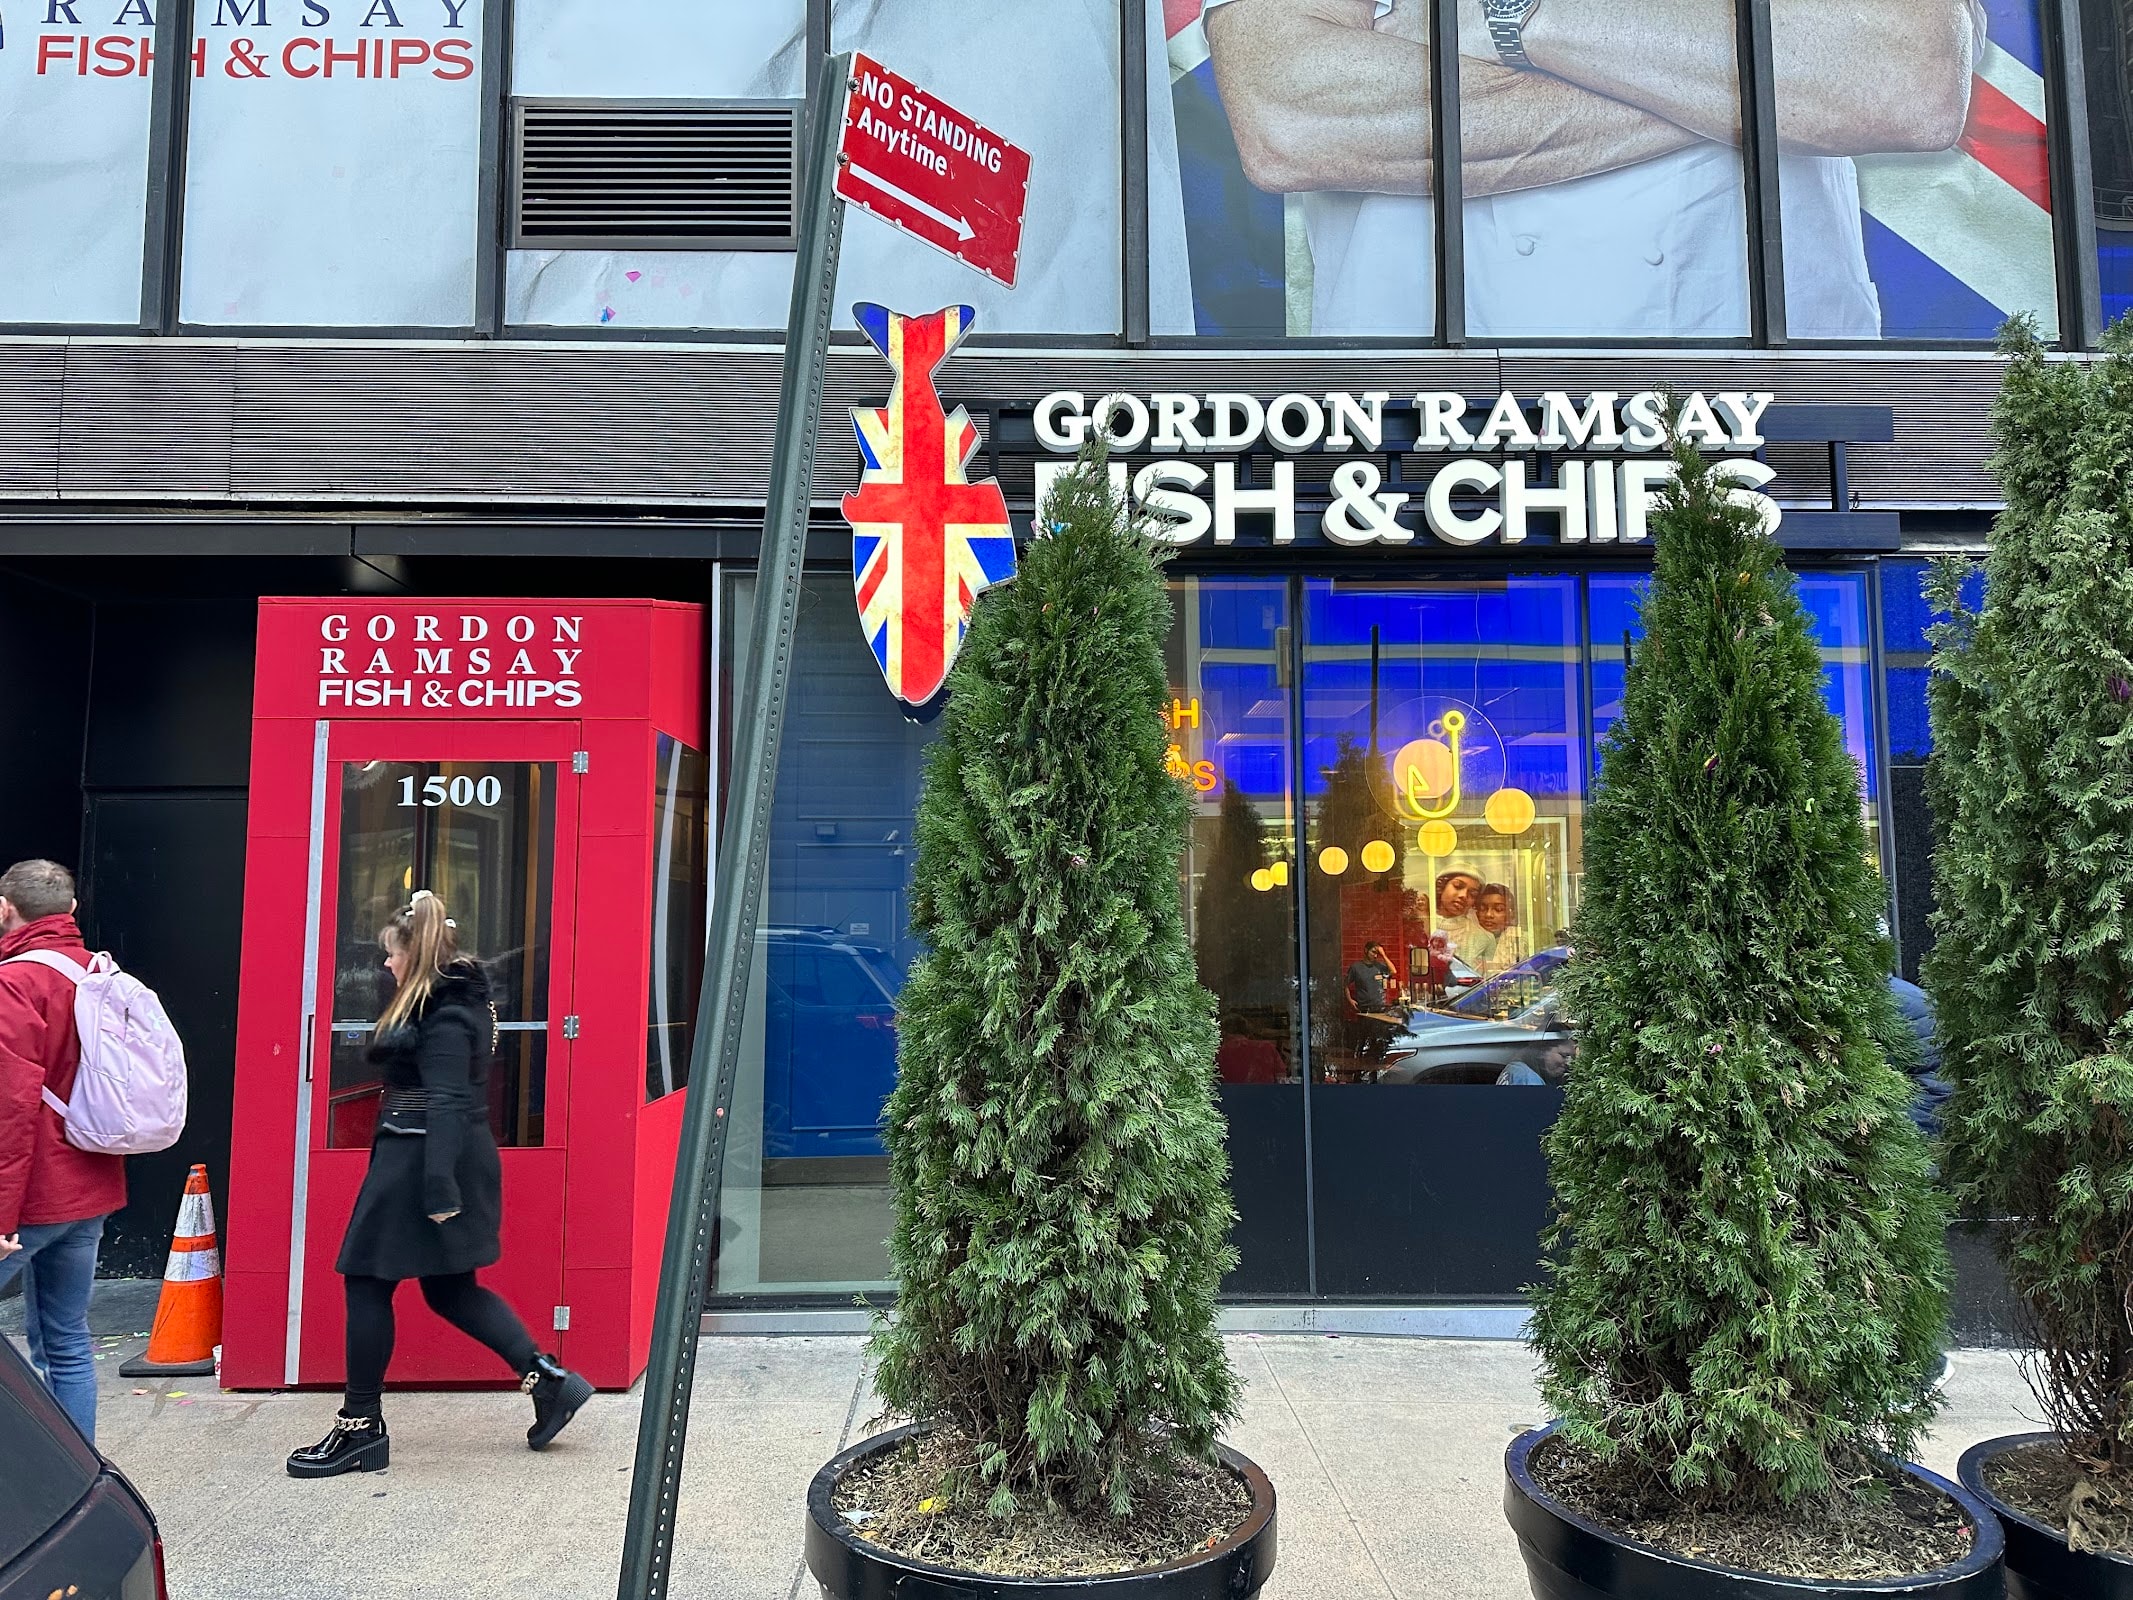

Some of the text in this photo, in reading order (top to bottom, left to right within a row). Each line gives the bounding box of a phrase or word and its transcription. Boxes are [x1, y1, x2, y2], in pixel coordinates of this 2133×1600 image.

[37, 35, 474, 80] FISH & CHIPS
[857, 106, 948, 176] Anytime
[861, 71, 1002, 174] NO STANDING
[1033, 390, 1775, 452] GORDON RAMSAY
[1321, 461, 1415, 546] &
[320, 614, 584, 642] GORDON
[319, 647, 583, 675] RAMSAY
[318, 679, 583, 708] FISH & CHIPS
[397, 775, 502, 807] 1500
